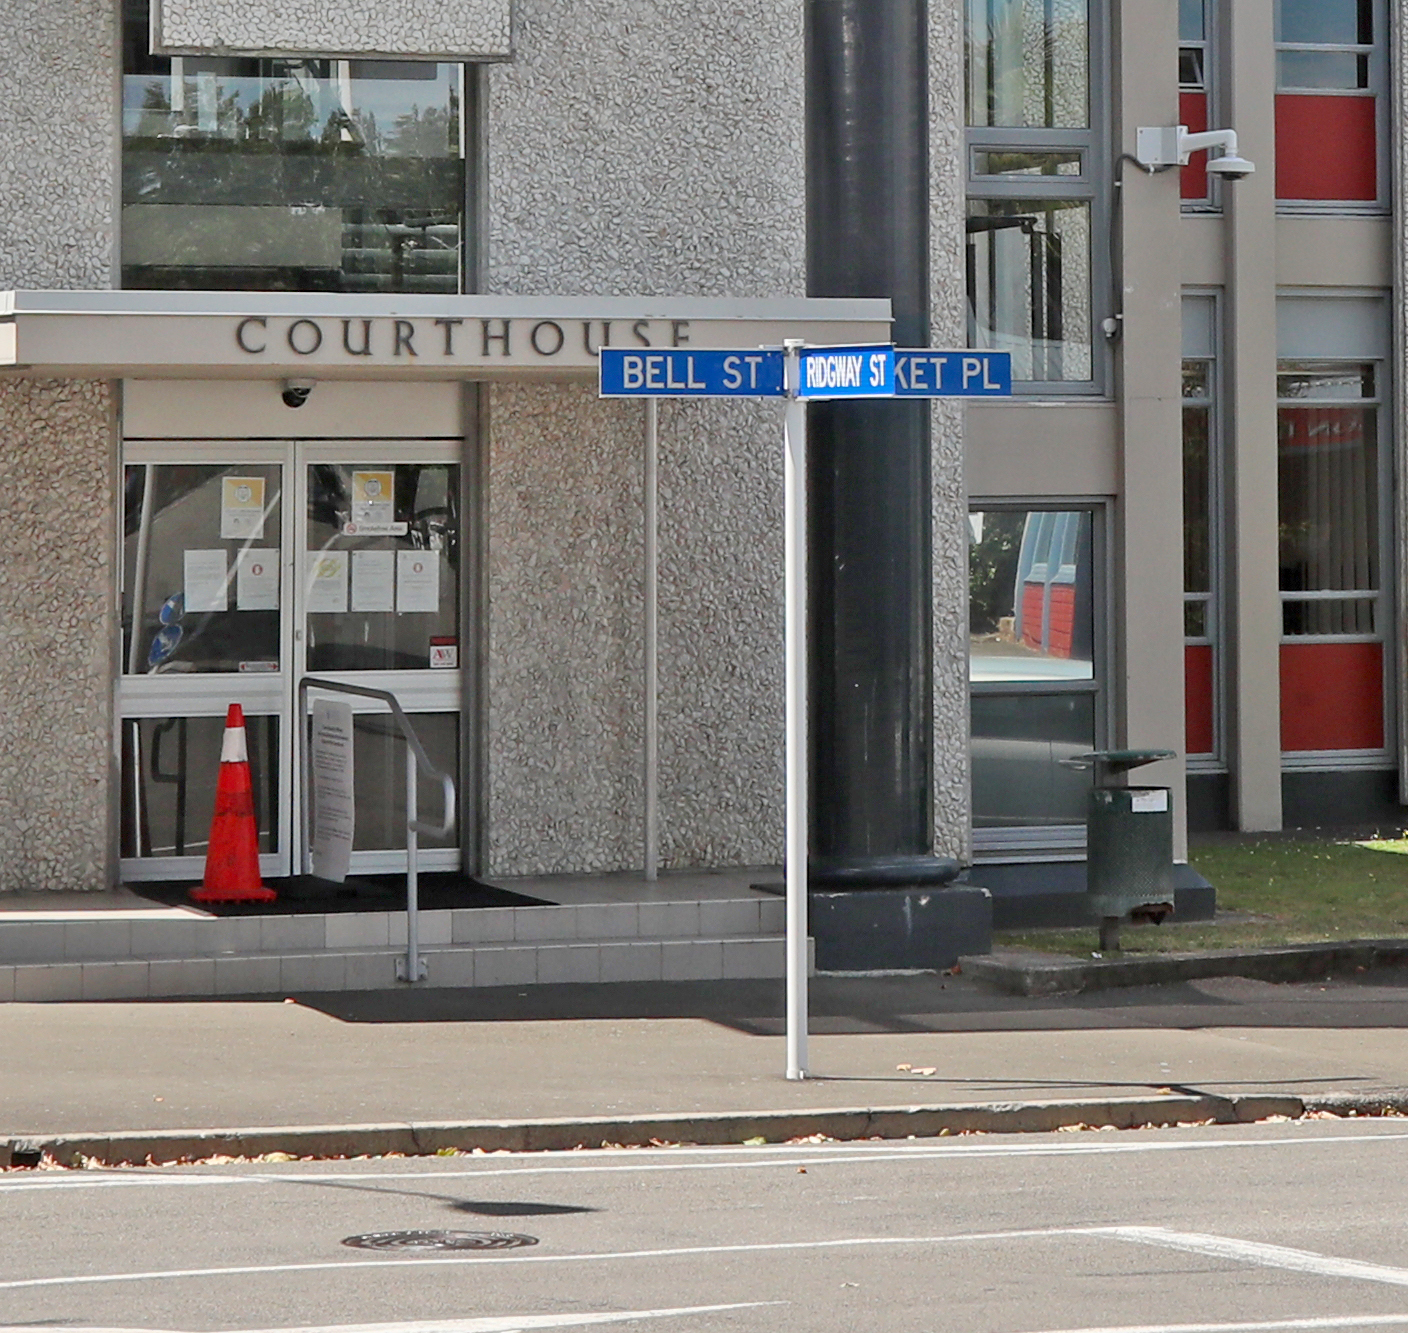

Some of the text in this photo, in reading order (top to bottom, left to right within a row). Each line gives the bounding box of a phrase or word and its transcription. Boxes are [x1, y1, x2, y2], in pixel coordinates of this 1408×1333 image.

[236, 317, 689, 357] COURTHOUSE
[622, 355, 763, 390] BELL ST
[805, 354, 886, 388] RIDGWAY ST
[894, 357, 1001, 390] KET PL
